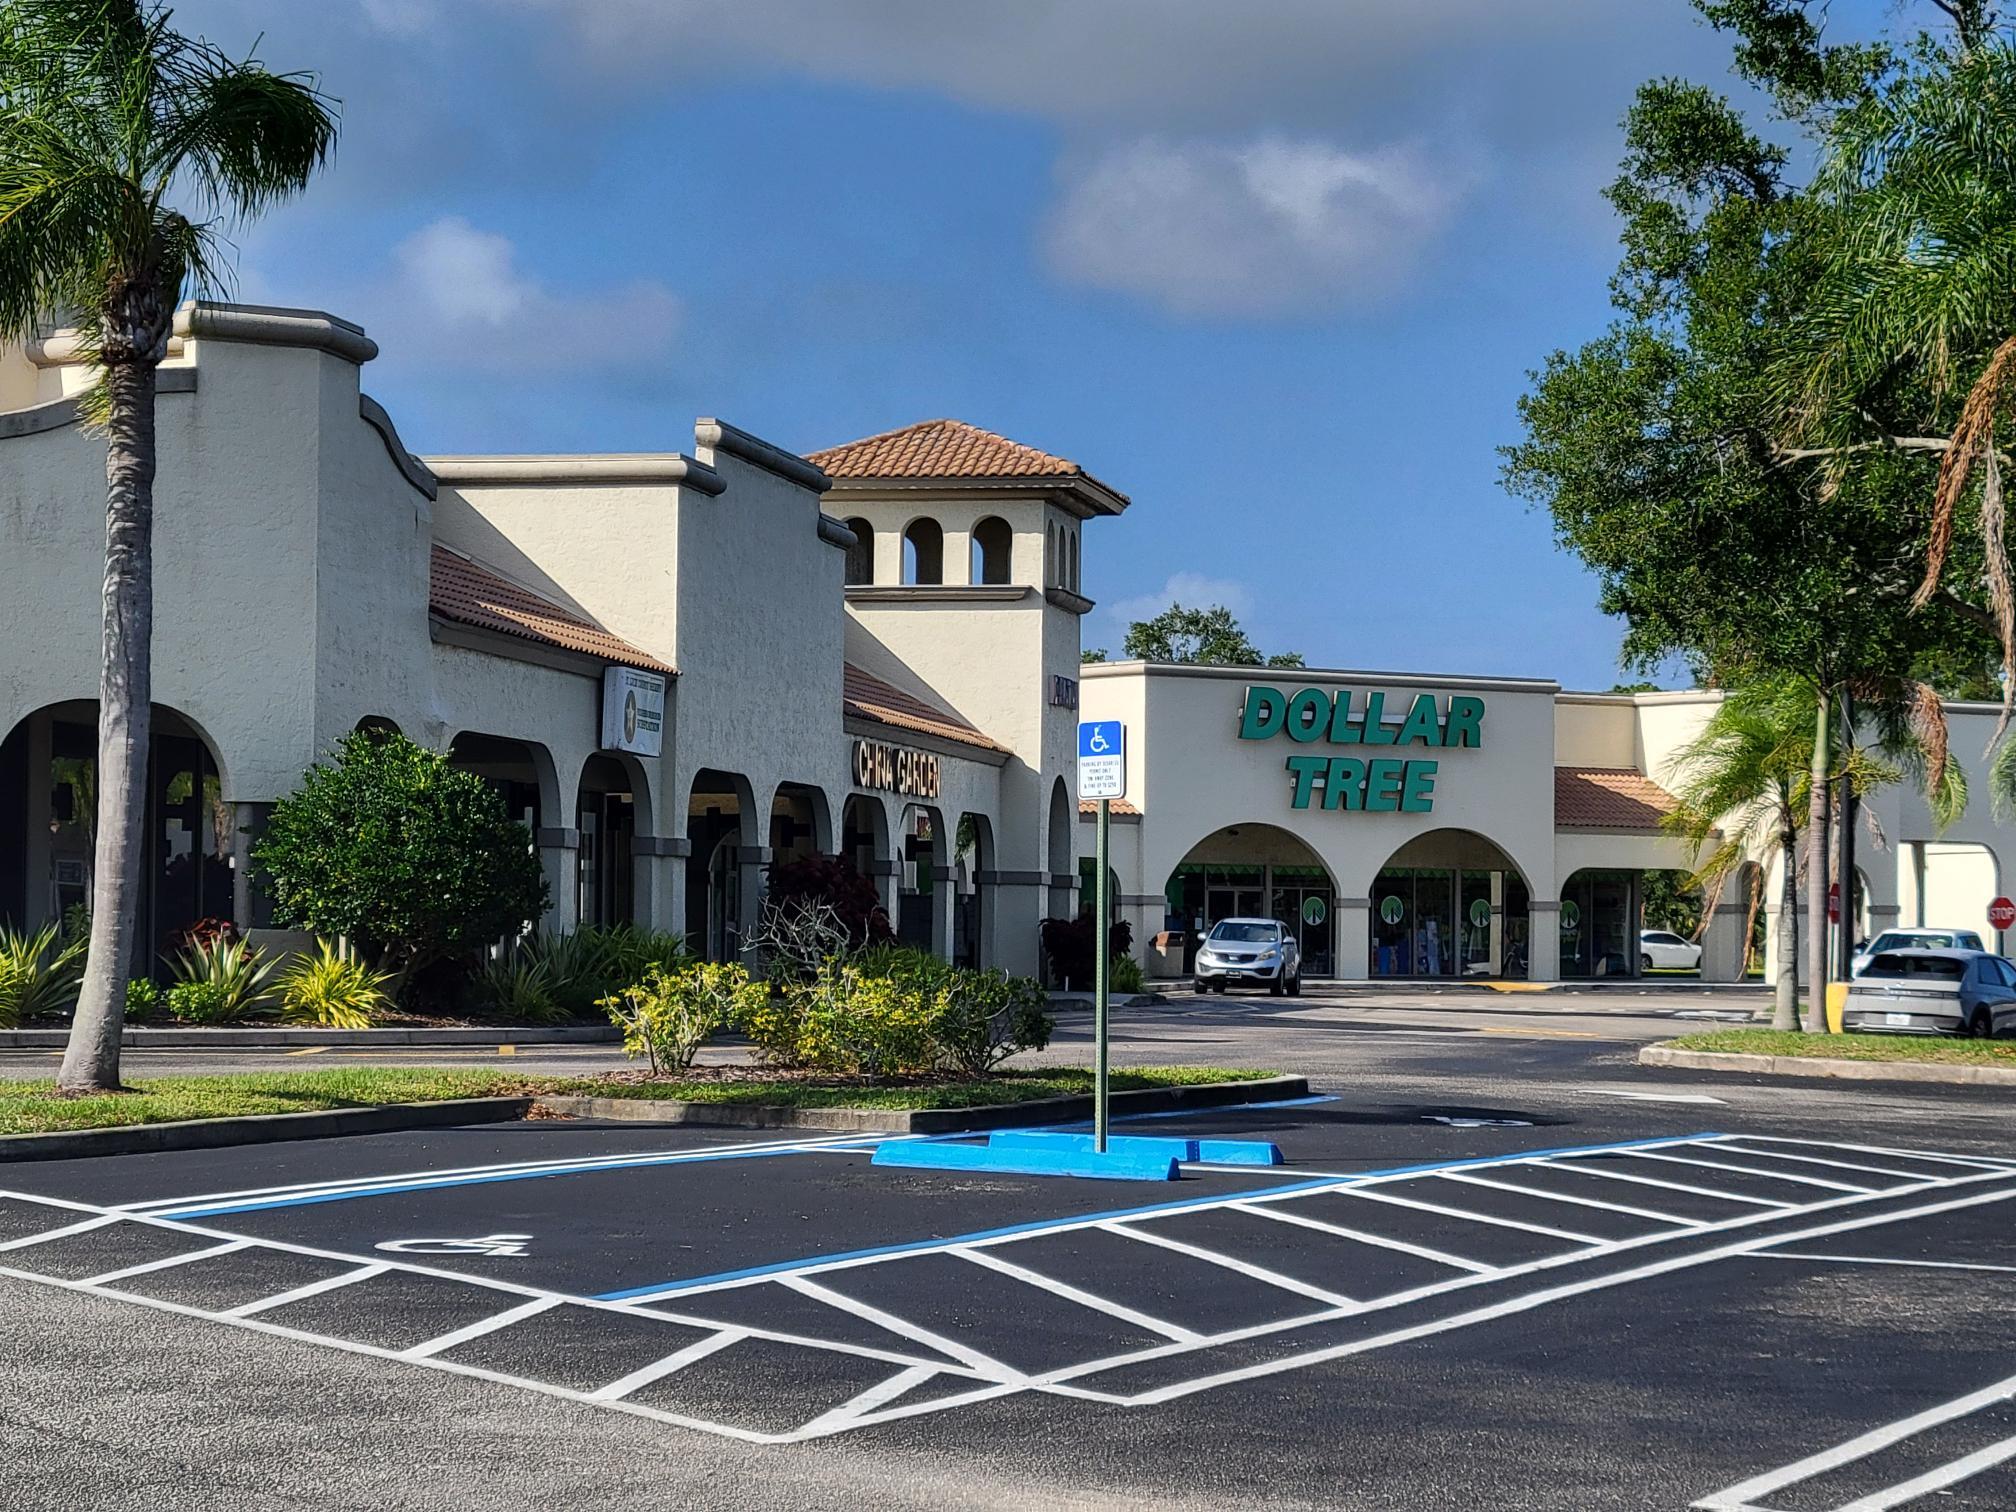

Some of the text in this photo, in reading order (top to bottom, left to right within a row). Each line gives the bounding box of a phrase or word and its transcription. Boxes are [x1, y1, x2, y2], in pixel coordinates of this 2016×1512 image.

[1238, 686, 1485, 748] DOLLAR
[858, 740, 940, 797] CHINA GARDEN
[1286, 756, 1438, 812] TREE
[1990, 907, 2015, 920] STOP
